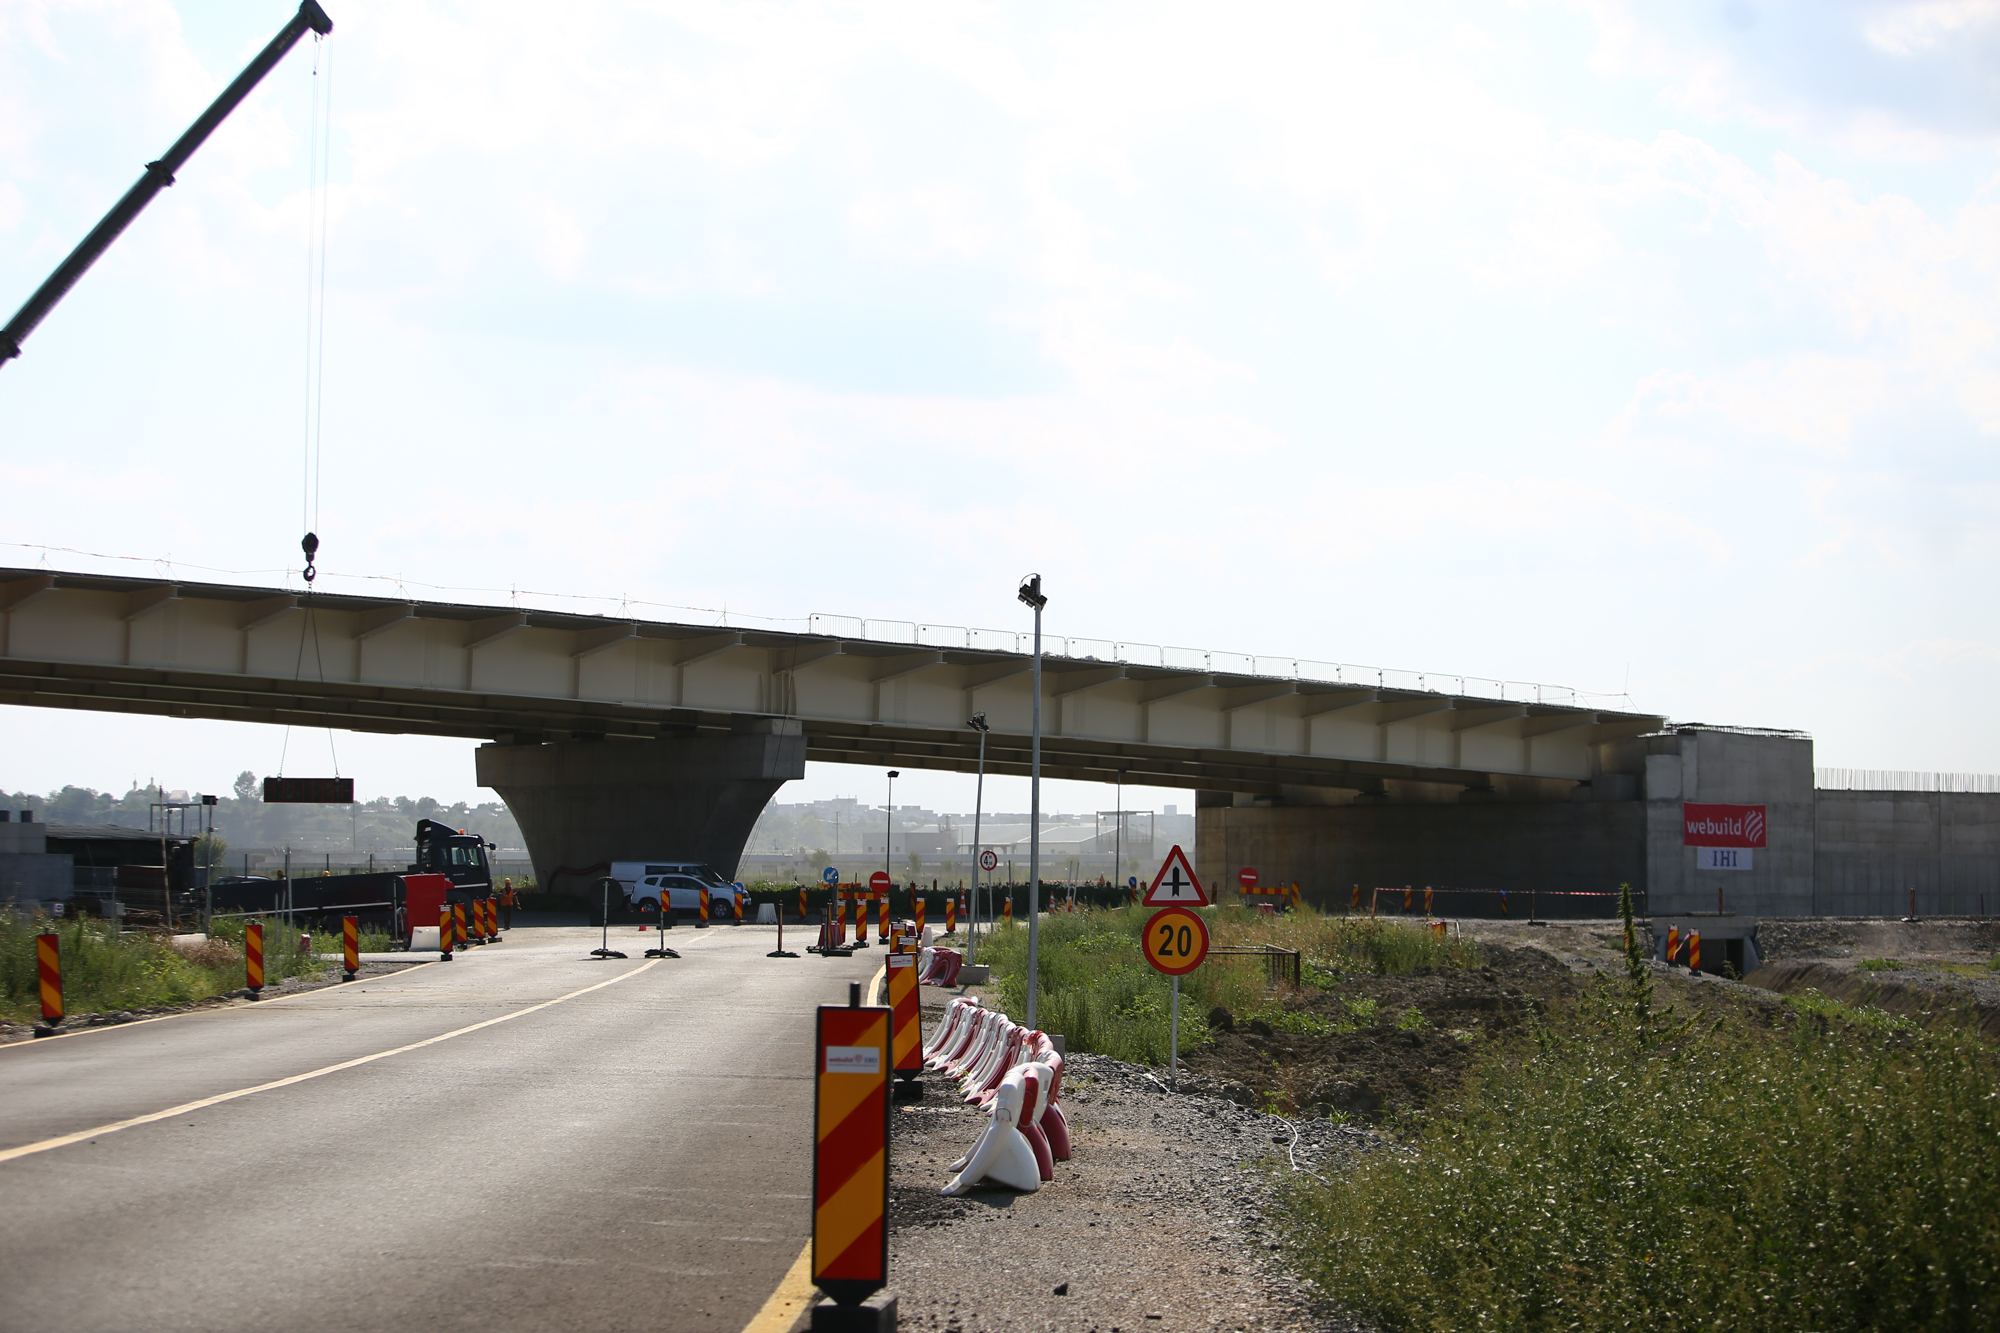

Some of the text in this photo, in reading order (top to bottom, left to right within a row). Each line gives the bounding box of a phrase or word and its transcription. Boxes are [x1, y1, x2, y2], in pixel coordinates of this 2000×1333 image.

[1687, 817, 1742, 835] webuild
[1712, 850, 1737, 867] IHI
[1158, 924, 1192, 957] 20
